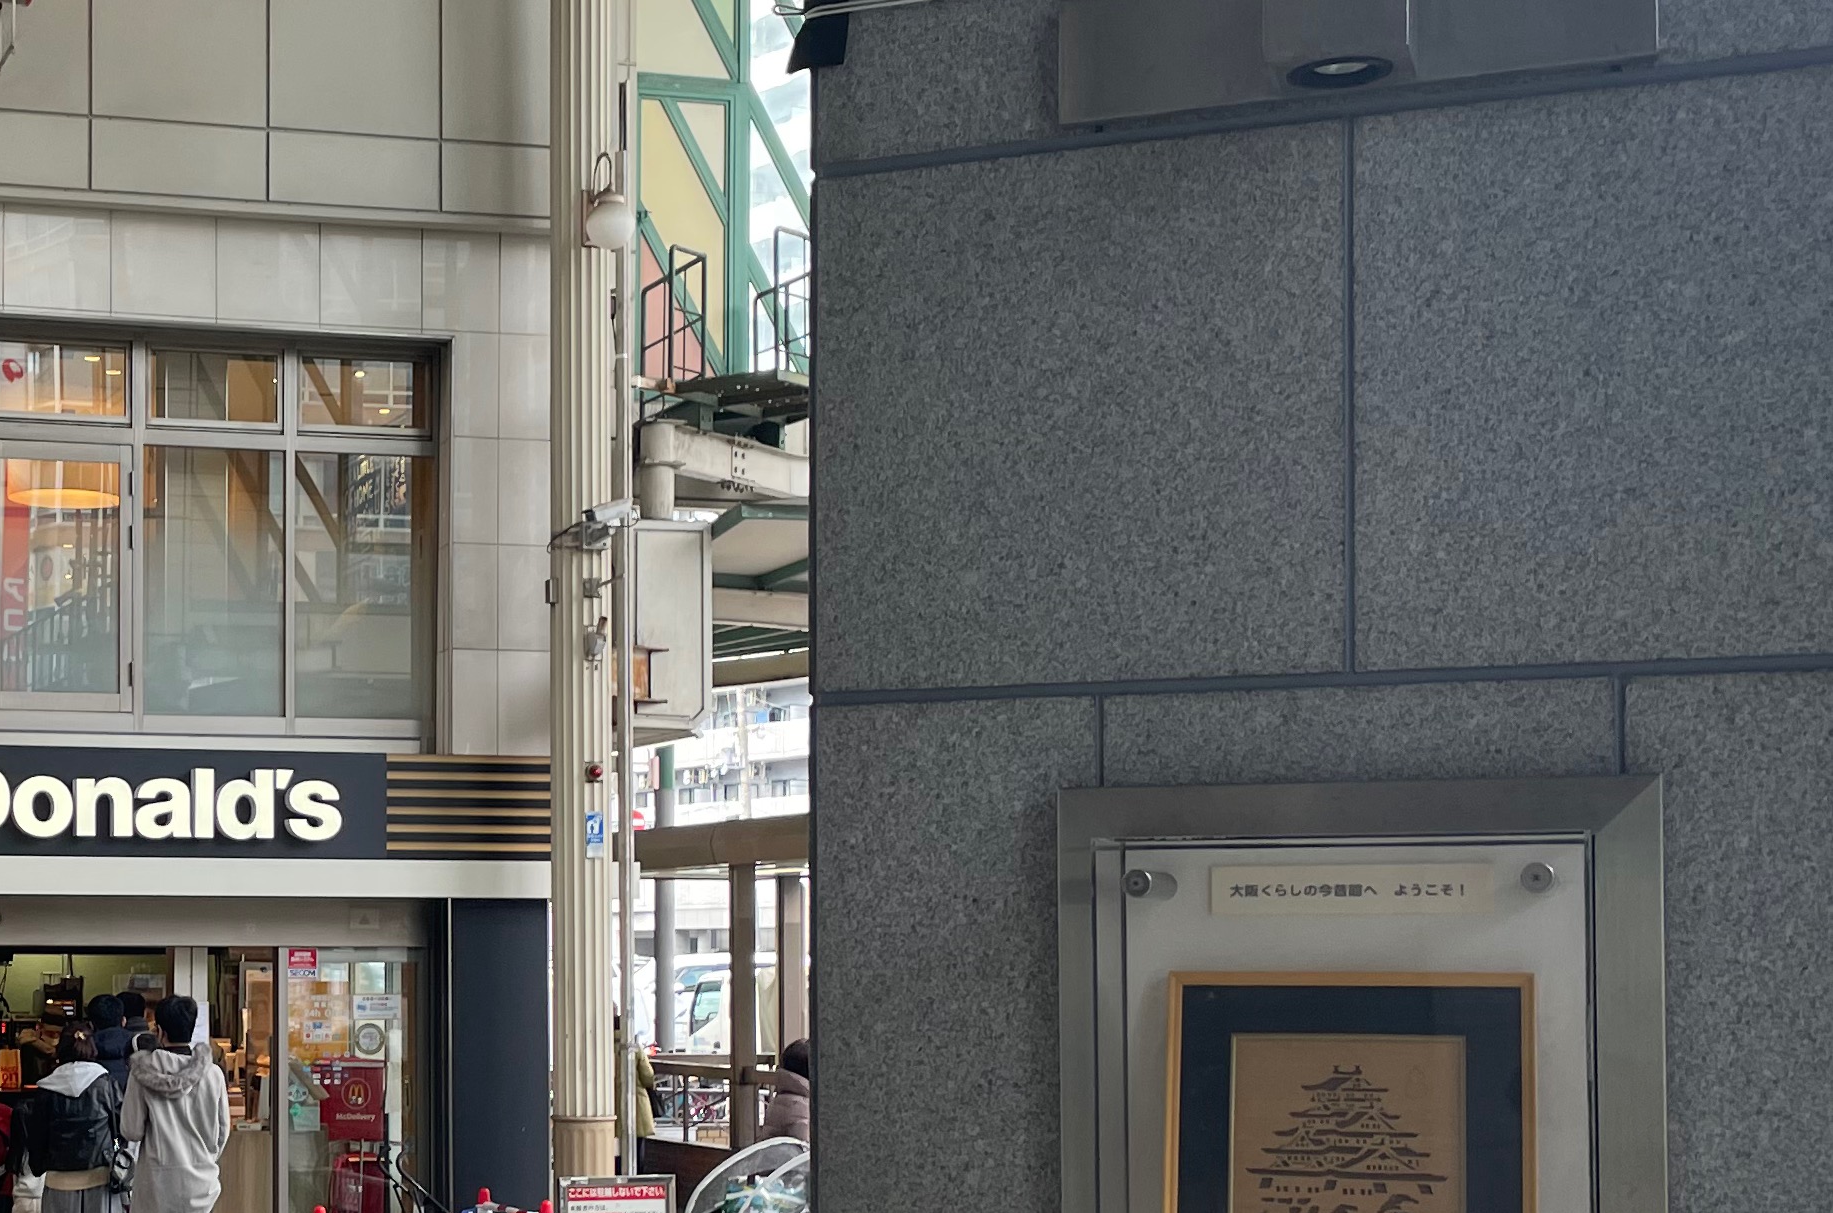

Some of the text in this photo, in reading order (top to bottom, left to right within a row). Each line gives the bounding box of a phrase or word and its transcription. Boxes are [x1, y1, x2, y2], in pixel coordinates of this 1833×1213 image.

[1229, 883, 1378, 898] 大阪くらしの今昔館へ
[289, 969, 316, 977] SECOM
